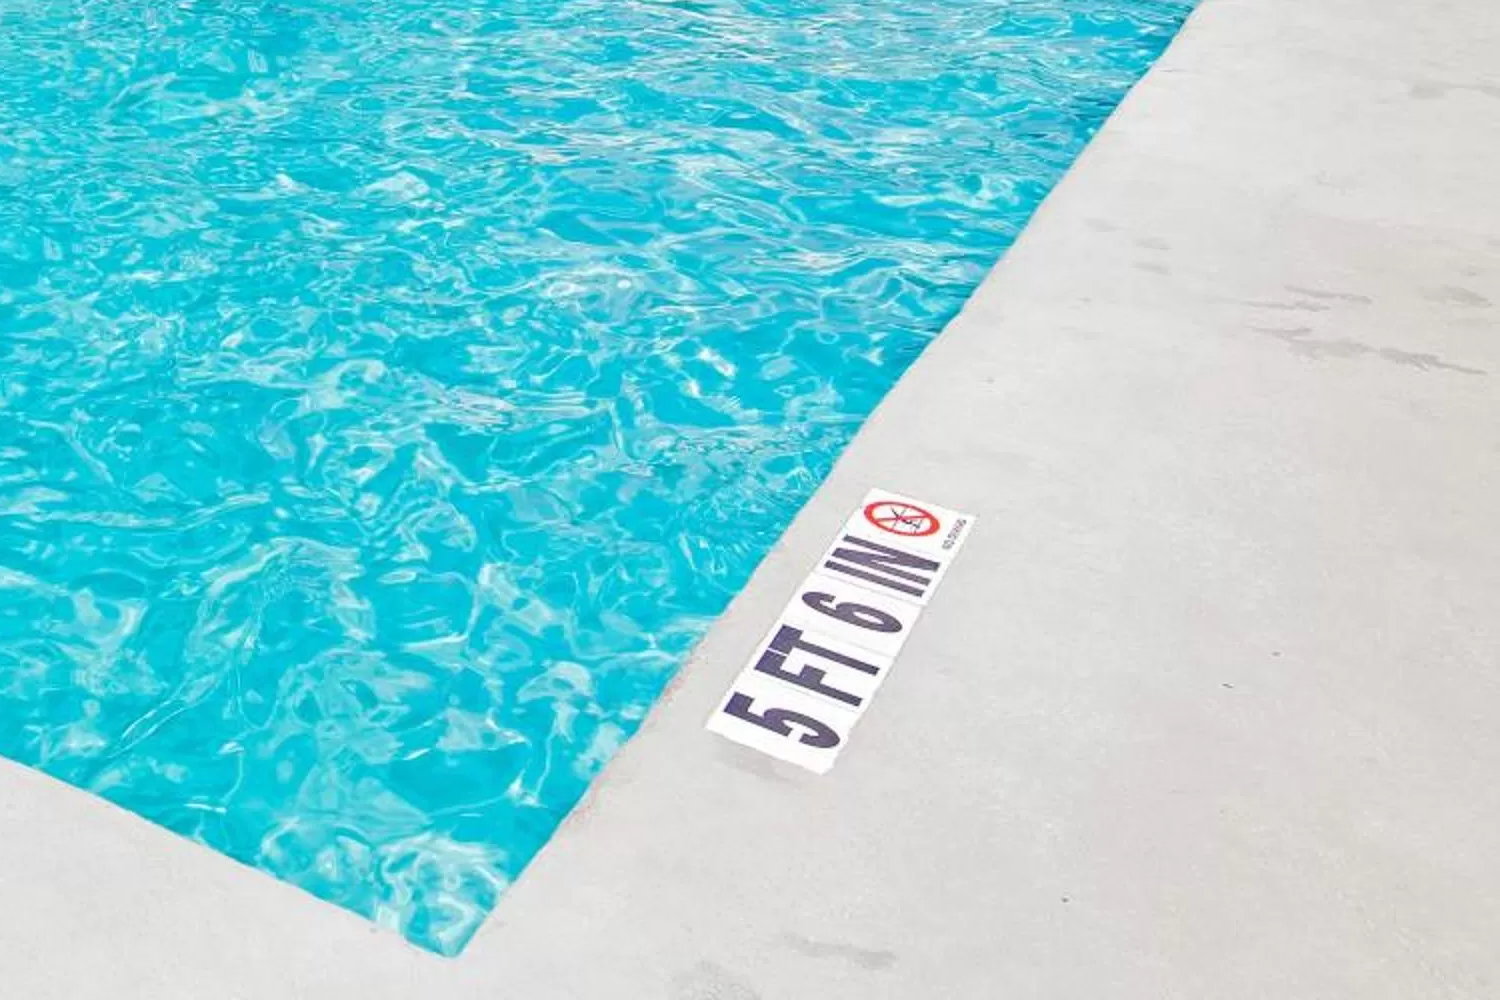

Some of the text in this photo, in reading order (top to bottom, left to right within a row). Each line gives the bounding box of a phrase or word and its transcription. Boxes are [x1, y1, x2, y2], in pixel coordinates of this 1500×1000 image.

[723, 534, 941, 749] 5 FT 6 IN
